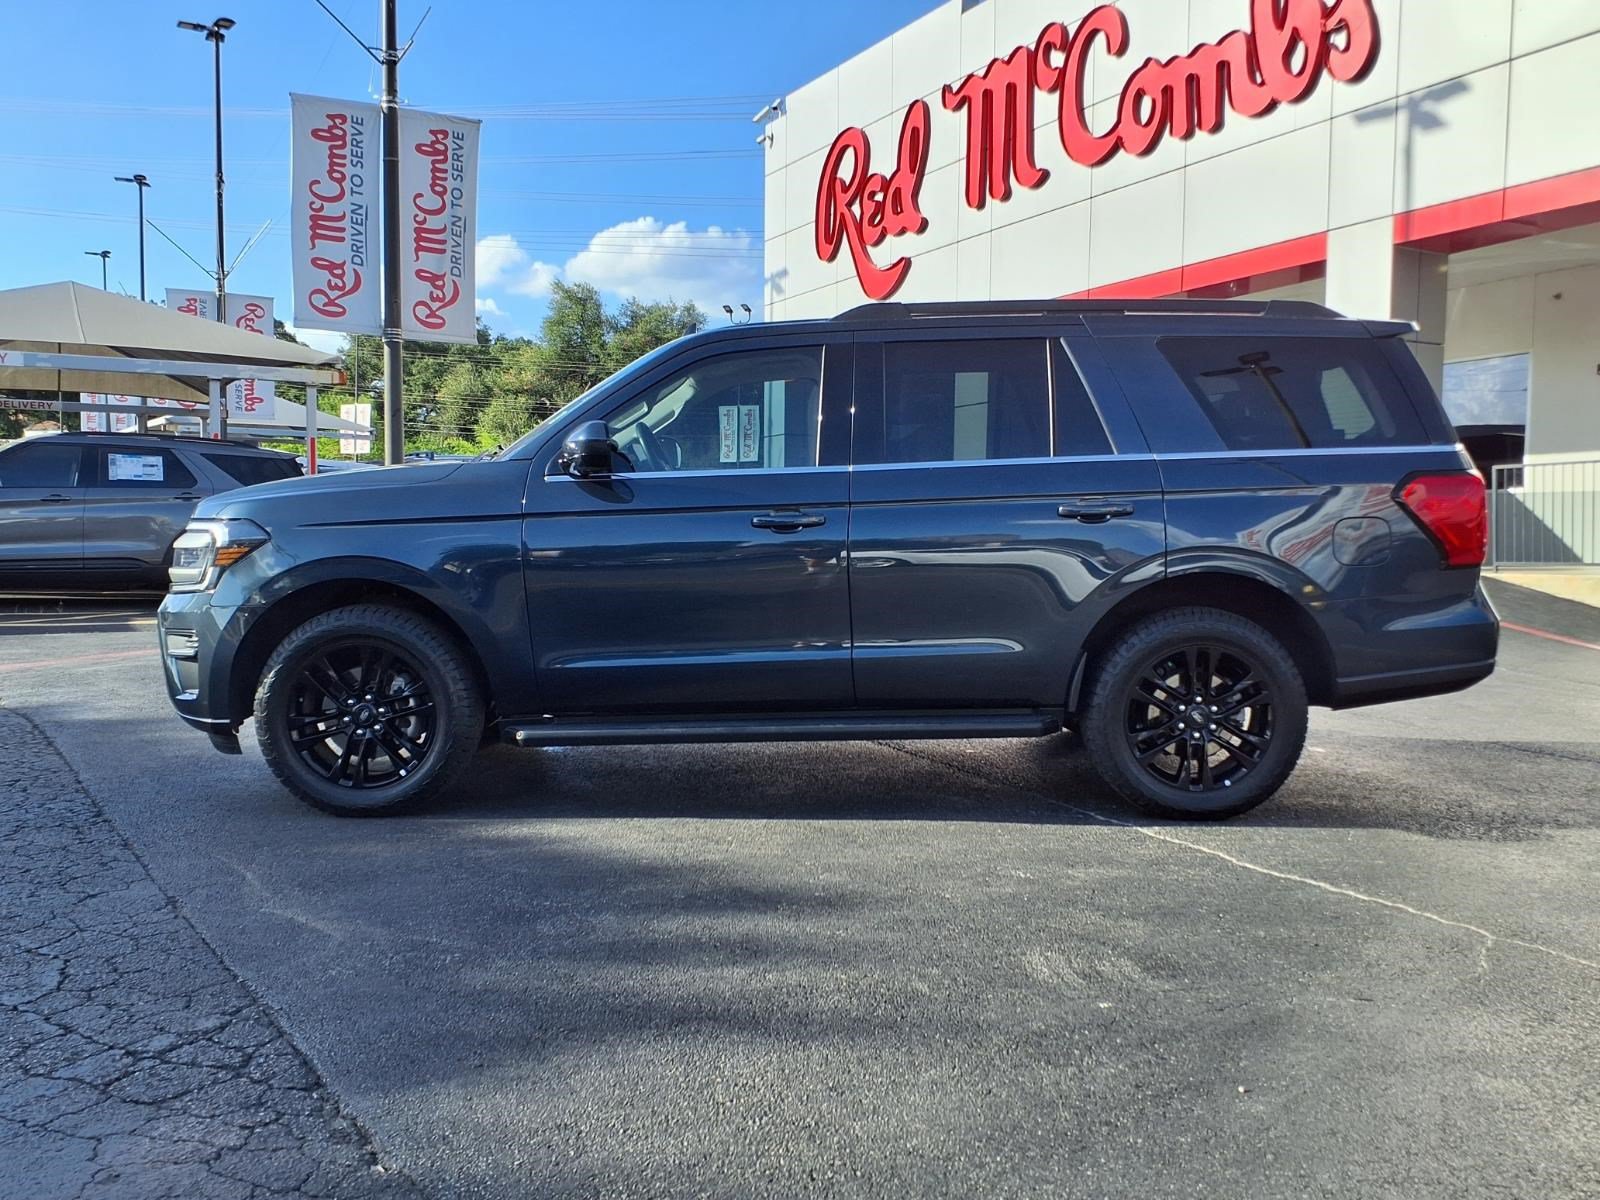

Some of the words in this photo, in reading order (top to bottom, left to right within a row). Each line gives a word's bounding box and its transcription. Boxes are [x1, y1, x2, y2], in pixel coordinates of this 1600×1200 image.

[350, 114, 365, 171] SERVE
[451, 130, 465, 183] SERVE
[815, 99, 930, 300] Red
[942, 0, 1380, 209] McCombs
[308, 113, 348, 250] McCombs
[350, 177, 364, 197] TO
[413, 129, 449, 262] McCombs
[450, 187, 463, 209] TO
[350, 203, 364, 267] DRIVEN
[450, 215, 463, 278] DRIVEN
[236, 302, 266, 335] Red
[308, 256, 362, 319] Red
[412, 268, 460, 330] Red
[234, 383, 243, 412] SERVE
